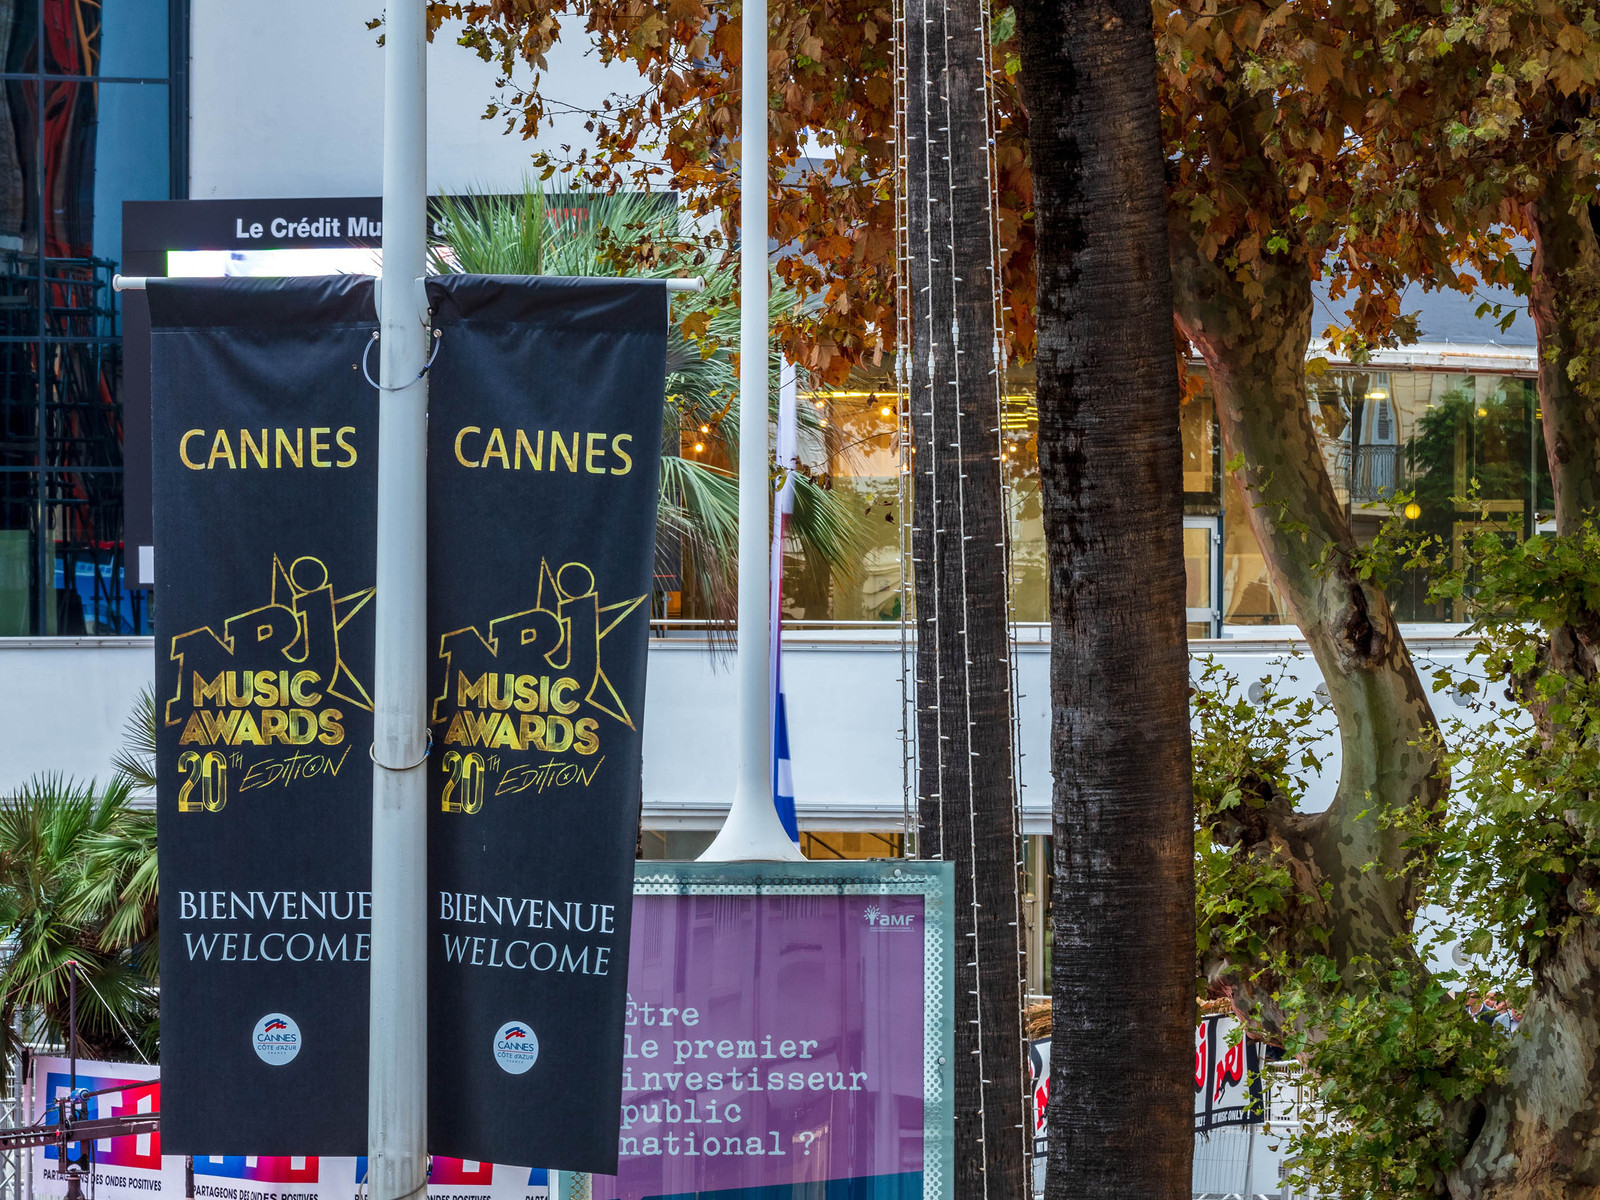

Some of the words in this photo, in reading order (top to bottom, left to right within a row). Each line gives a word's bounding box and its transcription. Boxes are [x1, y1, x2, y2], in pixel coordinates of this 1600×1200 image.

[236, 218, 263, 238] Le
[270, 217, 341, 238] Crédit
[347, 217, 382, 237] Mu
[179, 427, 358, 470] CANNES
[454, 426, 633, 476] CANNES
[192, 669, 322, 711] MUSIC
[457, 672, 581, 715] MUSIC
[178, 708, 345, 746] AWARDS
[443, 711, 600, 755] AWARDS
[179, 891, 372, 920] BIENVENUE
[440, 891, 615, 934] BIENVENUE
[183, 932, 371, 962] WELCOME
[443, 933, 611, 976] WELCOME
[625, 993, 700, 1026] Être
[257, 1033, 297, 1042] CANNES
[497, 1041, 534, 1052] CANNES
[624, 1034, 659, 1058] le
[673, 1034, 819, 1065] premier
[622, 1066, 868, 1091] investisseur
[620, 1098, 742, 1129] public
[618, 1131, 787, 1156] national
[799, 1131, 815, 1156] ?
[105, 1175, 127, 1188] ONDES
[128, 1178, 162, 1192] POSITIVES
[193, 1185, 238, 1200] PARTAGEONS
[240, 1189, 250, 1200] DES
